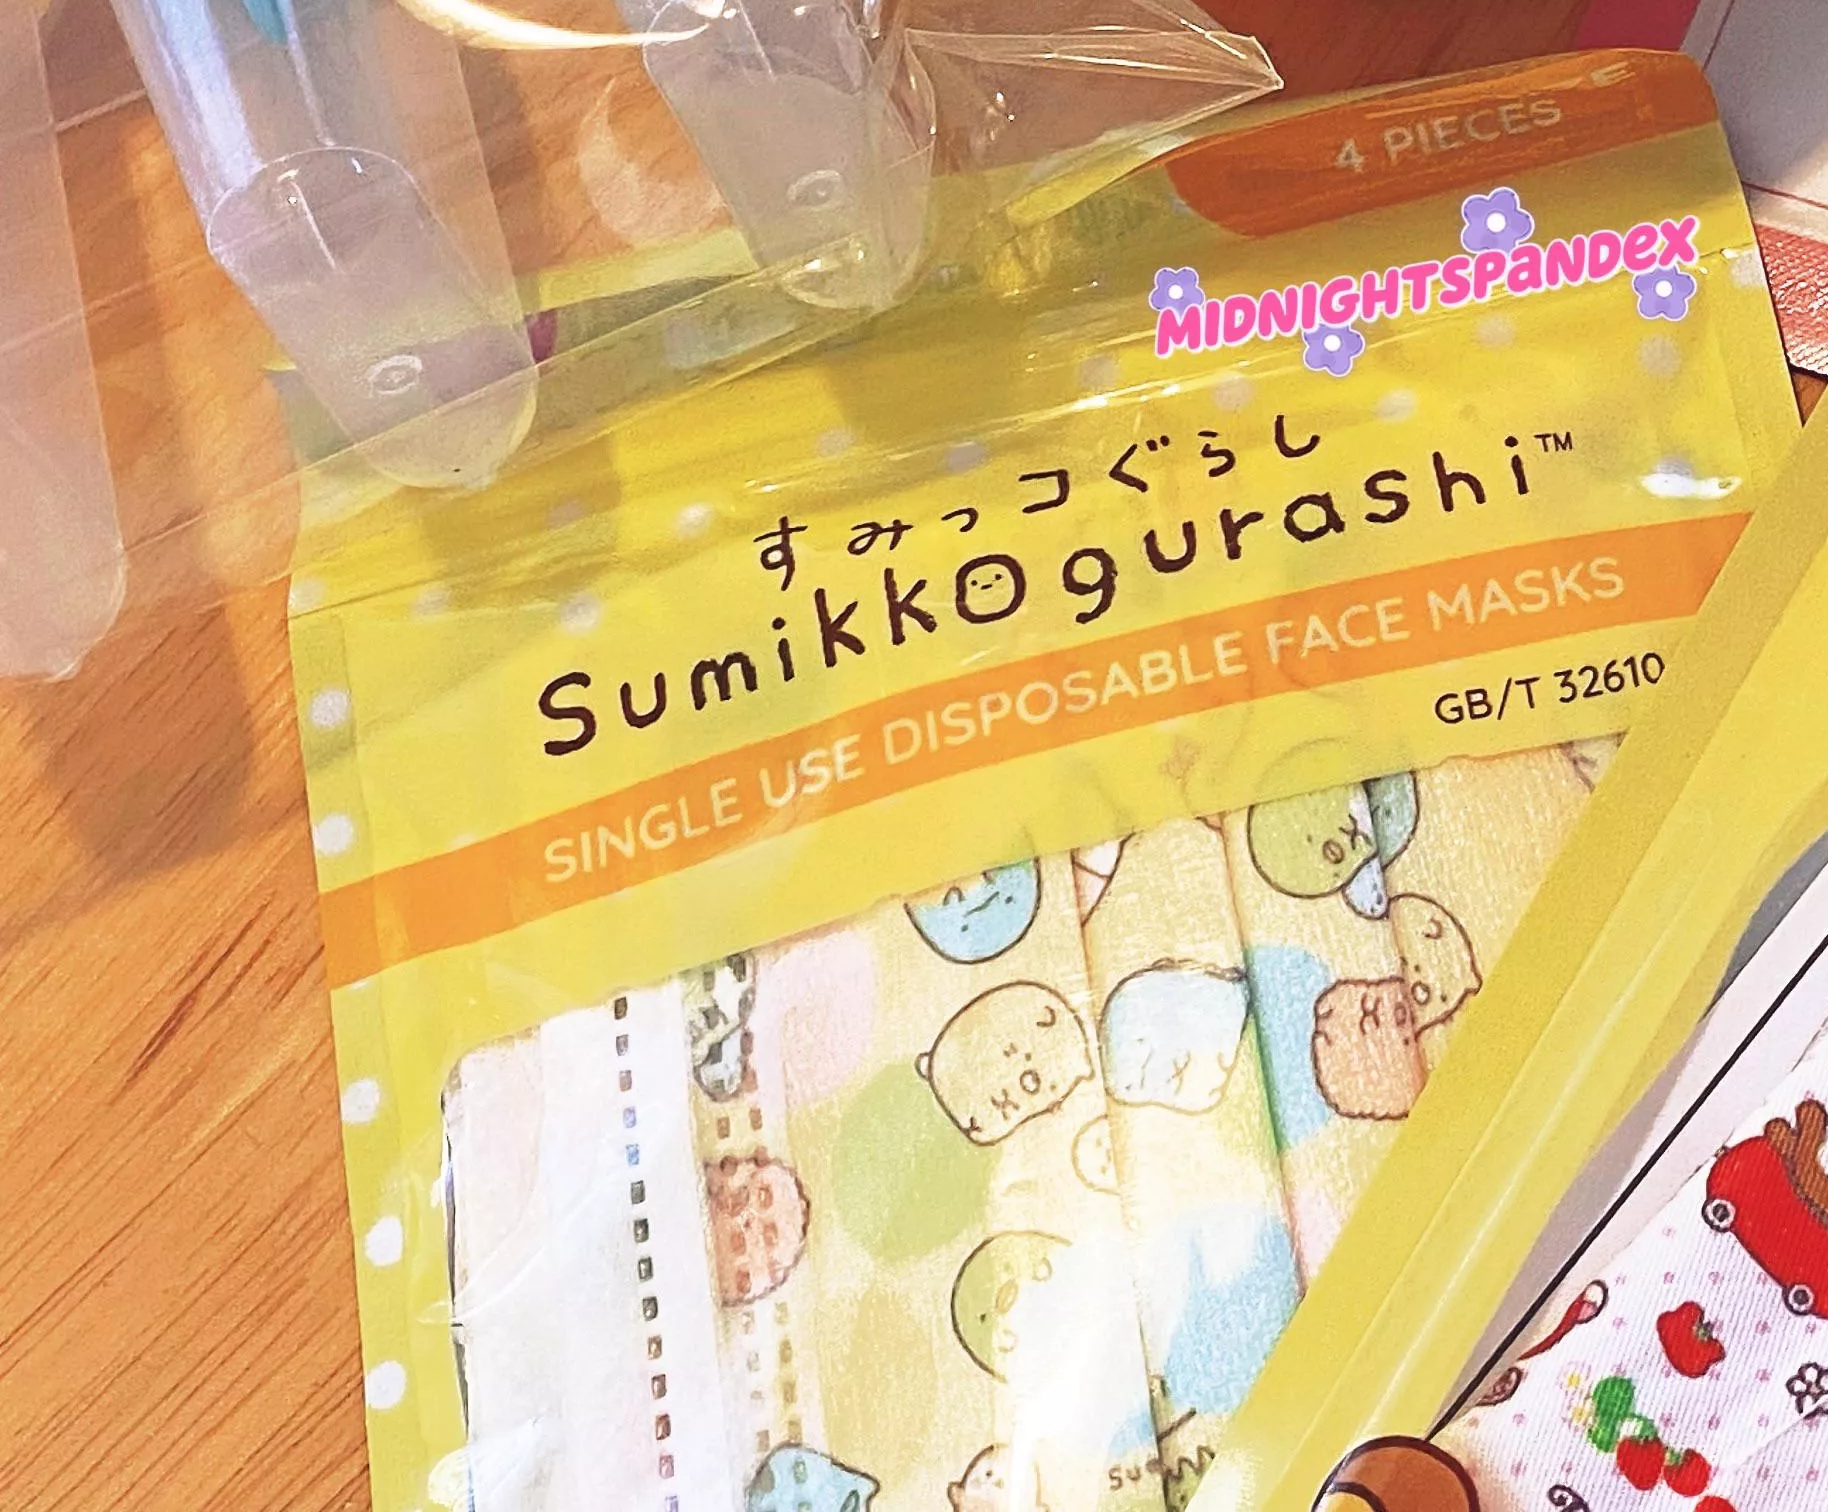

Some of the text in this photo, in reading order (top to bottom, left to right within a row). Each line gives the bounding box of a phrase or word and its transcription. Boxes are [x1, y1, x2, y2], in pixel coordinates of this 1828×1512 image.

[1333, 97, 1564, 175] 4 PIECES
[753, 413, 1321, 592] すみっコぐらし
[543, 554, 1626, 884] SINGLE USE DISPOSABLE FACE MASKS
[1433, 651, 1667, 728] GB/T 32610
